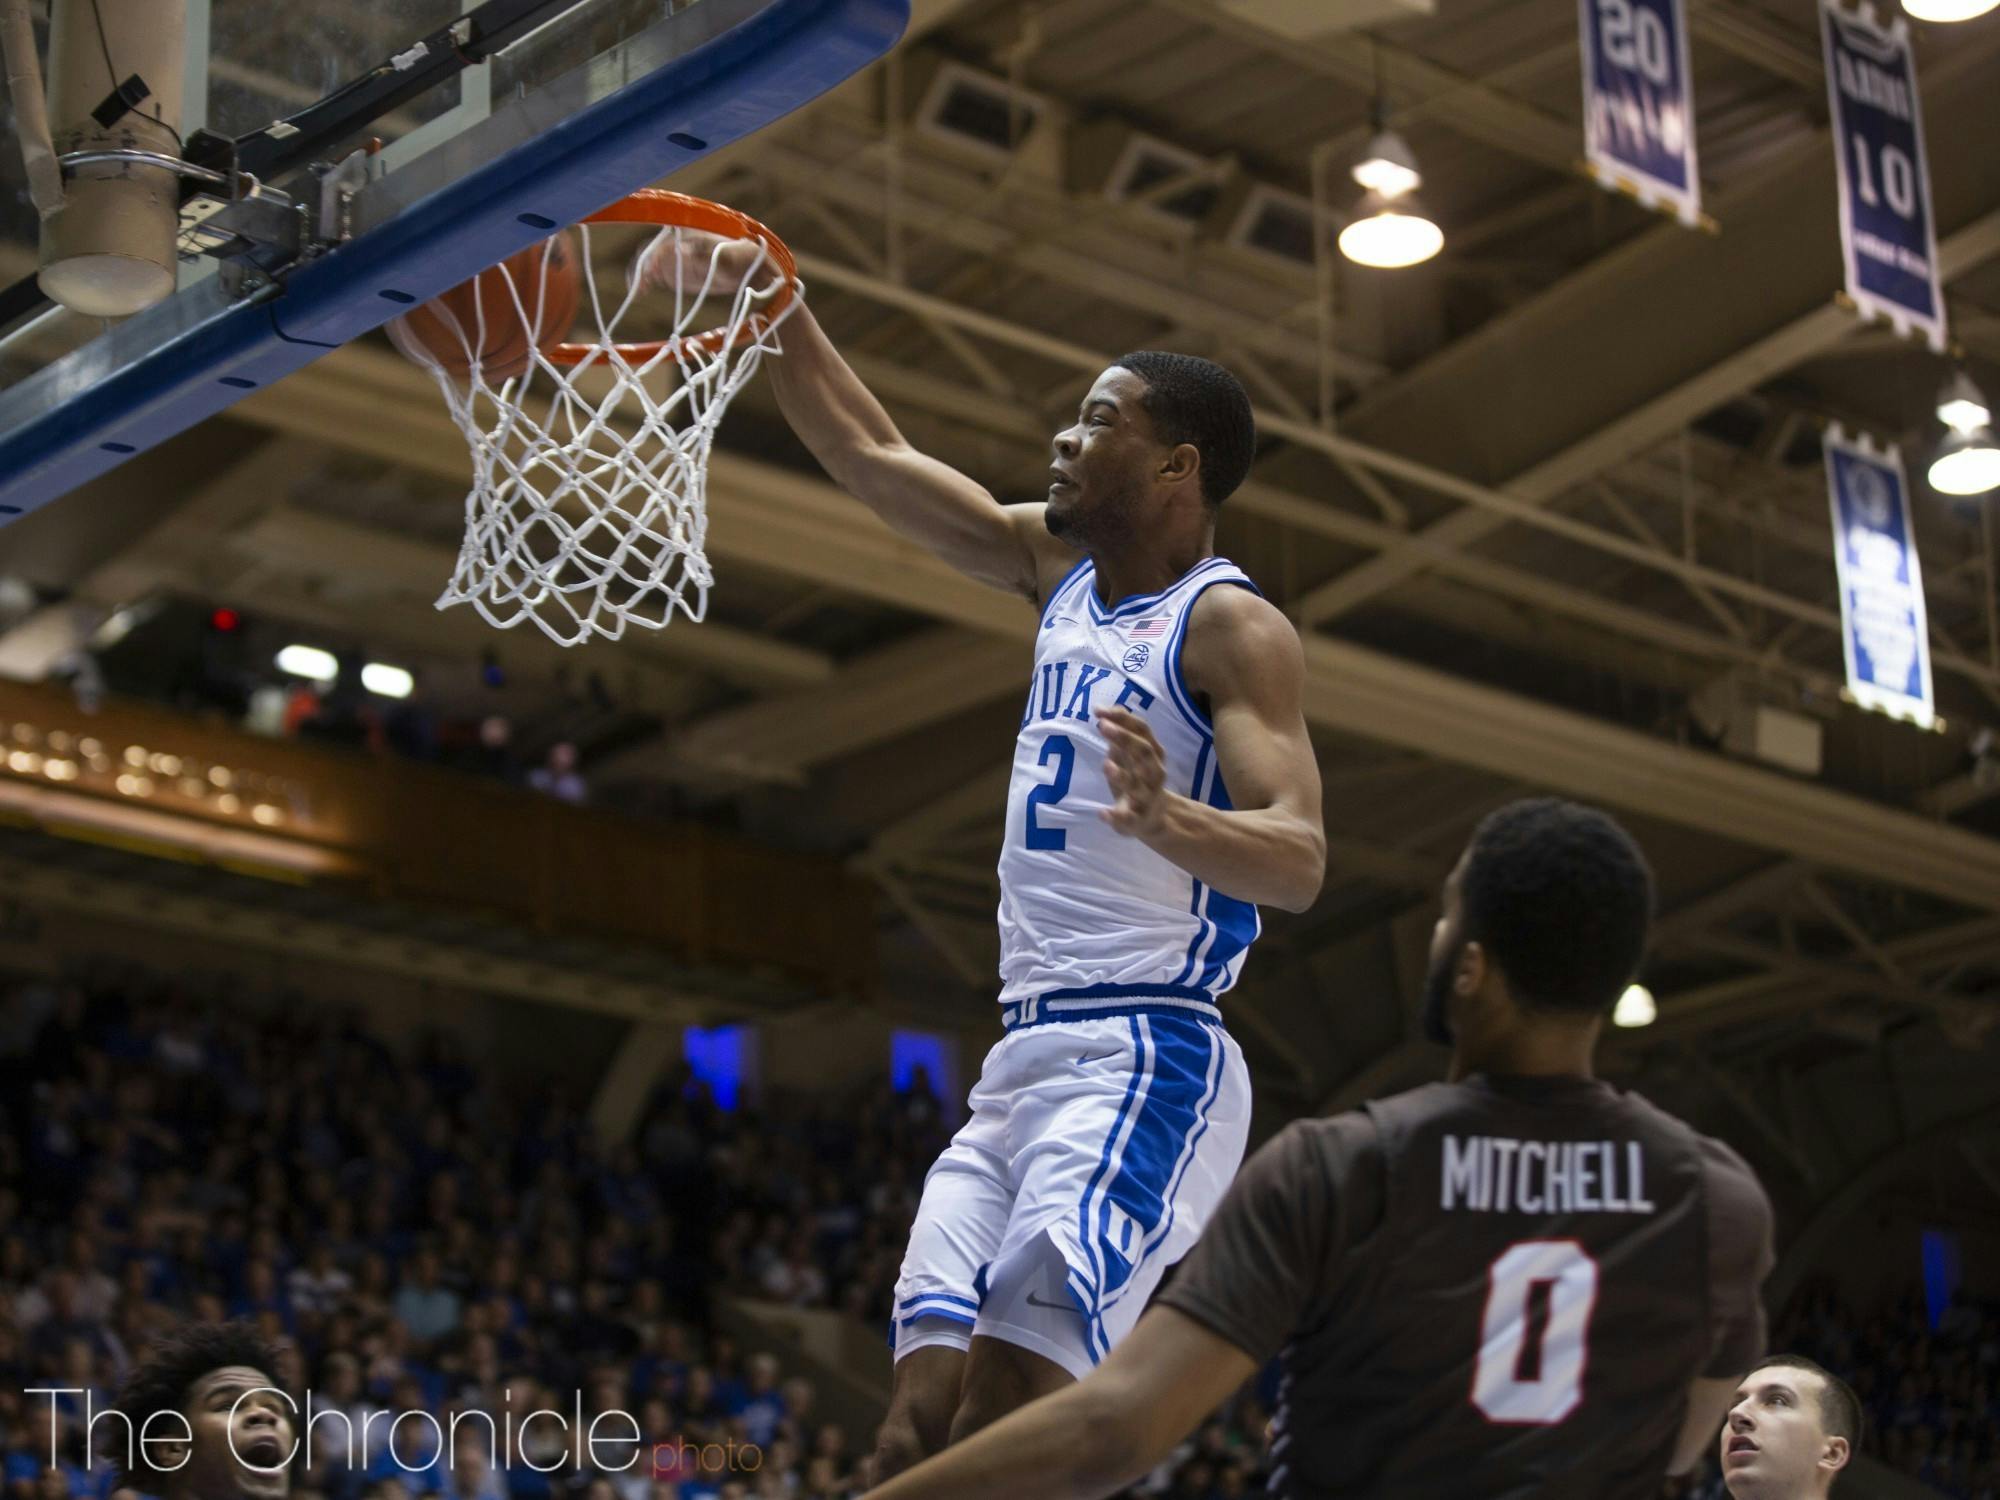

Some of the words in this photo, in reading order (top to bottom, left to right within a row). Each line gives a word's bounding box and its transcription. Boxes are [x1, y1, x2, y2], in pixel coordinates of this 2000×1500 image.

[1853, 134, 1915, 219] 10
[1127, 653, 1149, 663] ACC
[1025, 735, 1075, 850] 2
[1441, 1135, 1655, 1213] MITCHELL
[1470, 1236, 1598, 1425] 0
